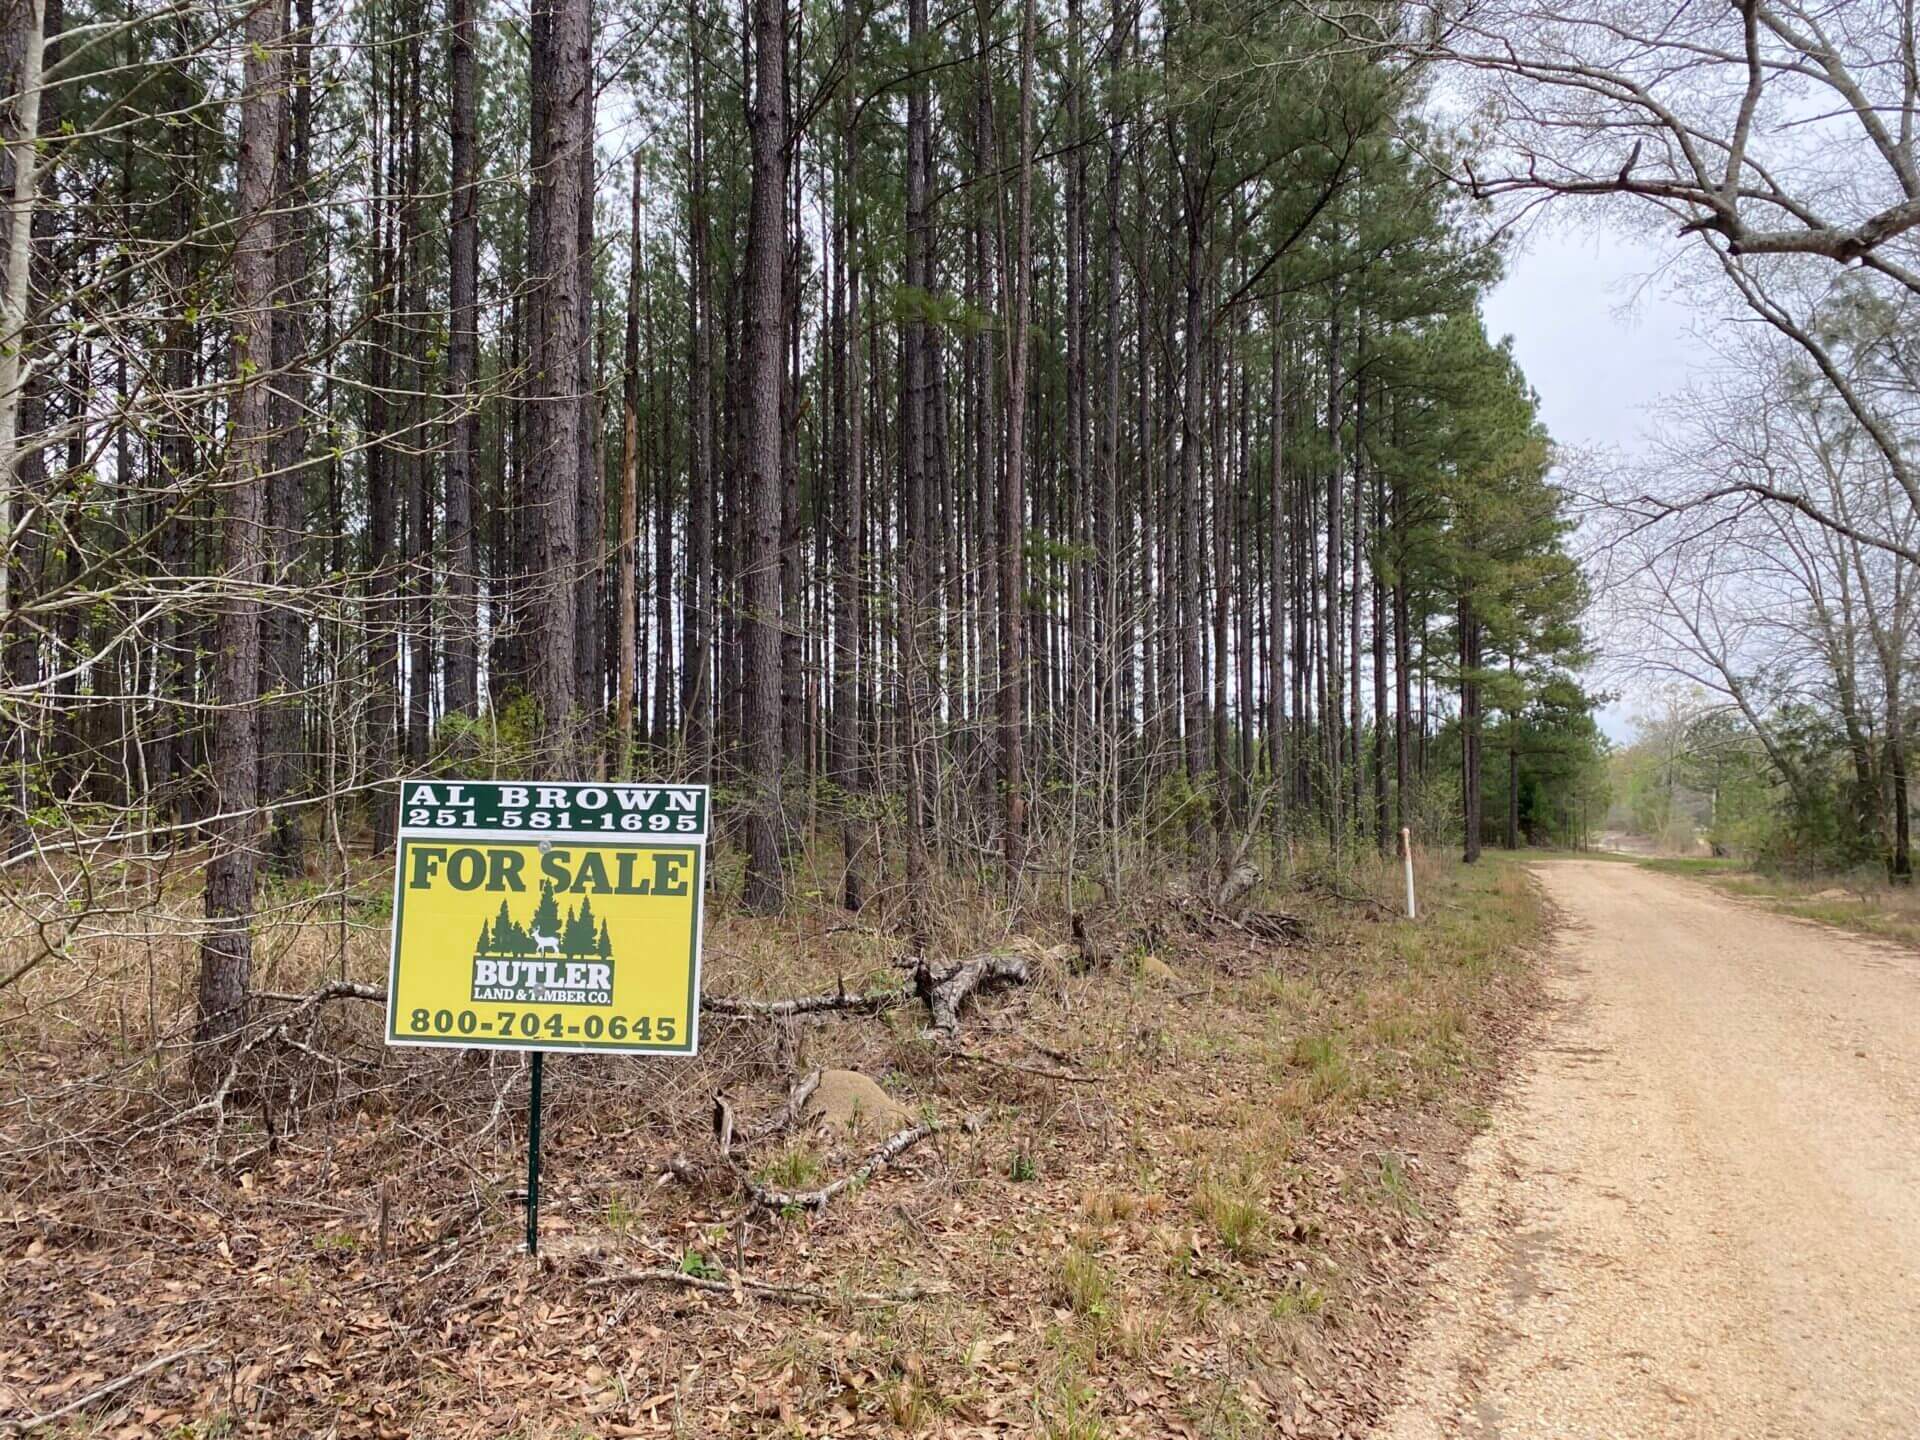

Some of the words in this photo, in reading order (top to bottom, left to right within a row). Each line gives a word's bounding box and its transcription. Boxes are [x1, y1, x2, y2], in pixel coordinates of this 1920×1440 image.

[407, 785, 475, 807] AL
[497, 786, 702, 812] BROWN
[408, 808, 698, 832] 251-581-1695
[409, 847, 527, 892] FOR
[539, 850, 689, 896] SALE
[474, 960, 612, 990] BUTLER
[473, 987, 514, 1000] LAND
[515, 989, 527, 1001] &
[588, 991, 611, 1004] CO.
[410, 1008, 677, 1041] 800-704-0645
